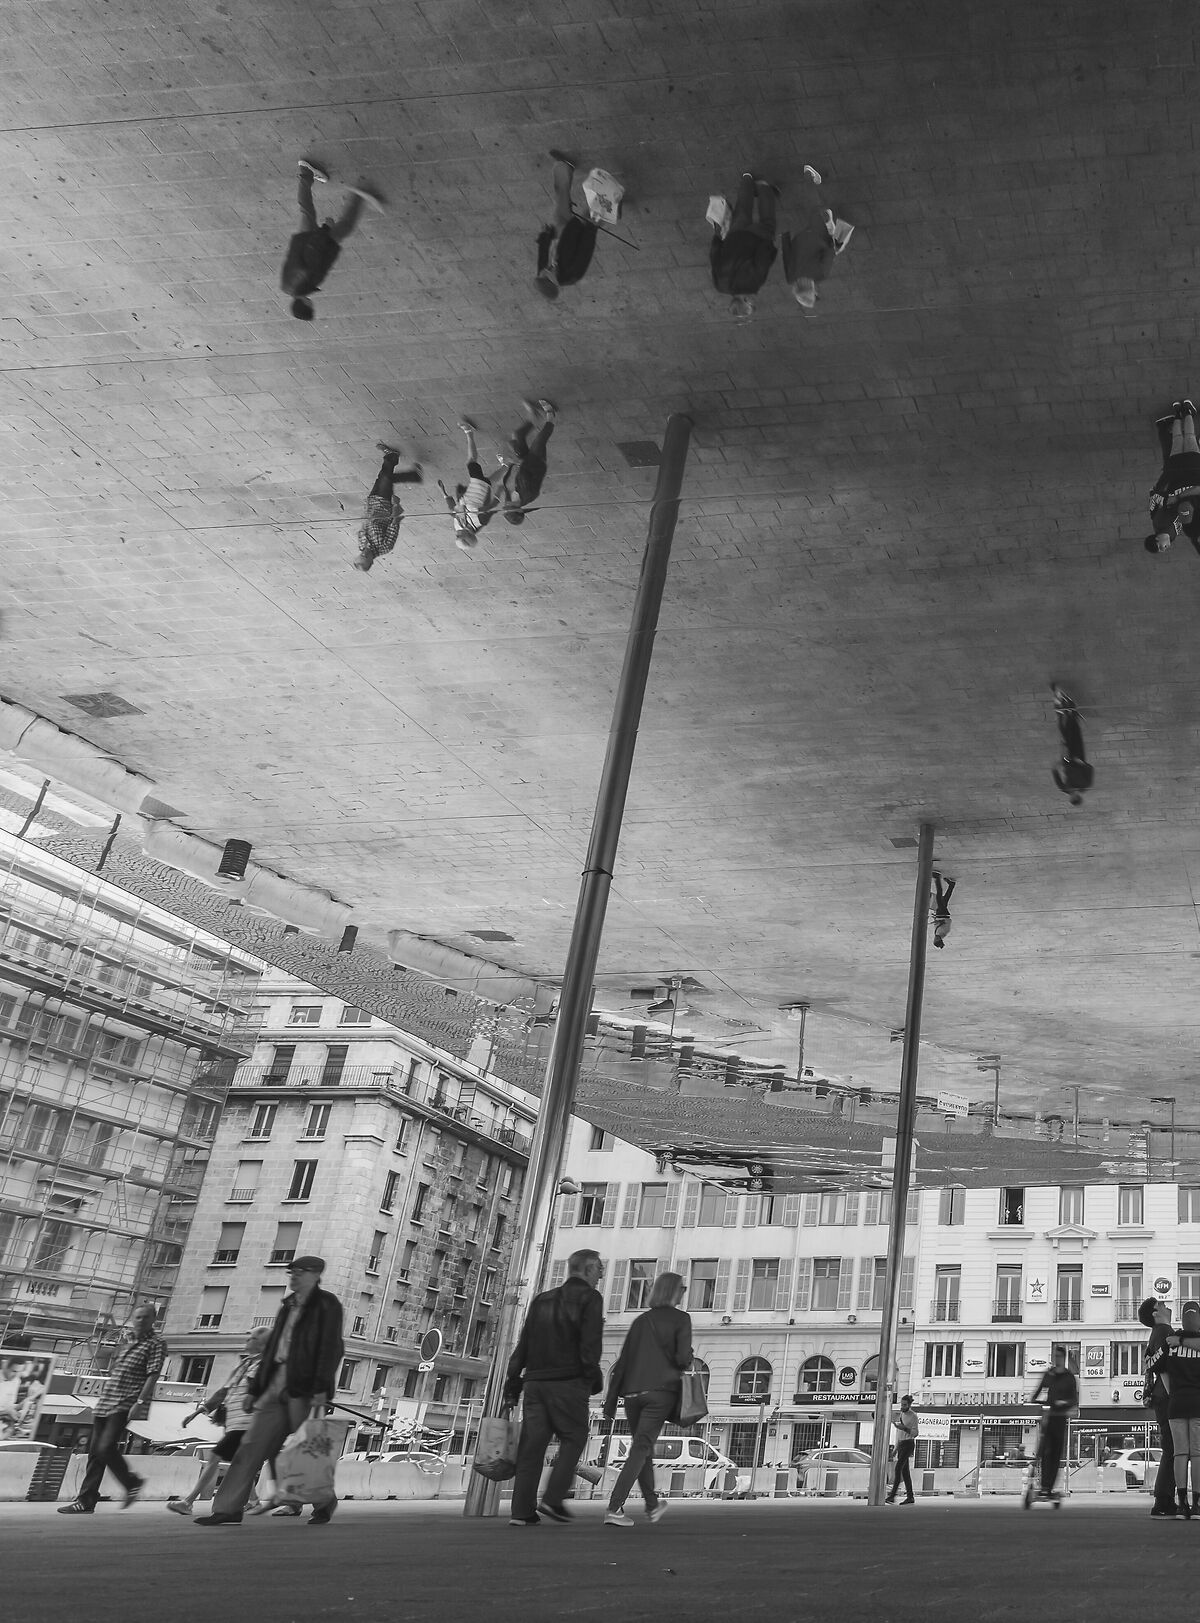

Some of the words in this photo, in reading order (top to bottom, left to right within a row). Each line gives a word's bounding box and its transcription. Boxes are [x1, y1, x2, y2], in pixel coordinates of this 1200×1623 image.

[1087, 1351, 1104, 1360] RTL2
[841, 1372, 854, 1380] LMB
[812, 1394, 860, 1402] RESTAURANT
[918, 1417, 950, 1426] GAGNERAUD
